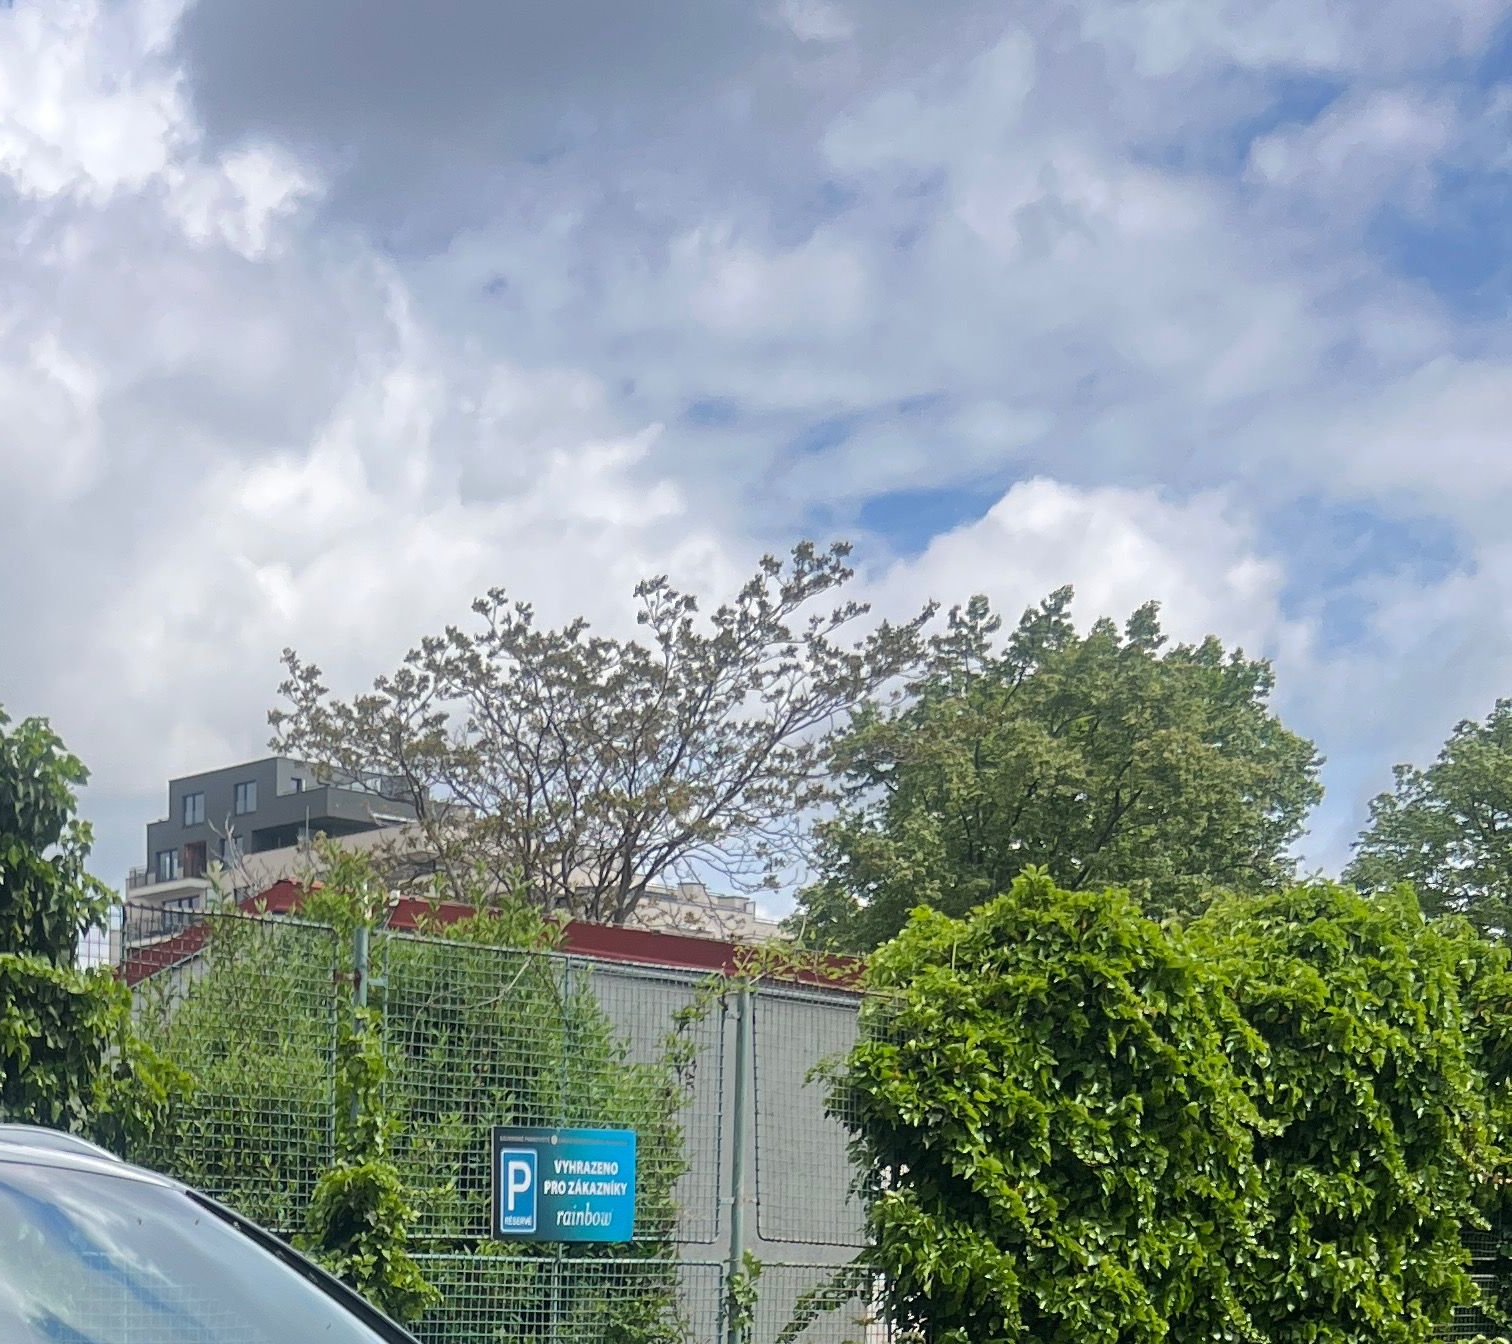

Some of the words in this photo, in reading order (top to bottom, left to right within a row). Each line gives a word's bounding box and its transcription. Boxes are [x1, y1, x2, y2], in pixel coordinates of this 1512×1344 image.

[554, 1159, 619, 1176] VYHRAZENO
[507, 1160, 532, 1211] P
[543, 1180, 567, 1195] PRO
[568, 1178, 628, 1196] ZÁKAZNÍKY
[556, 1202, 614, 1227] rainbow
